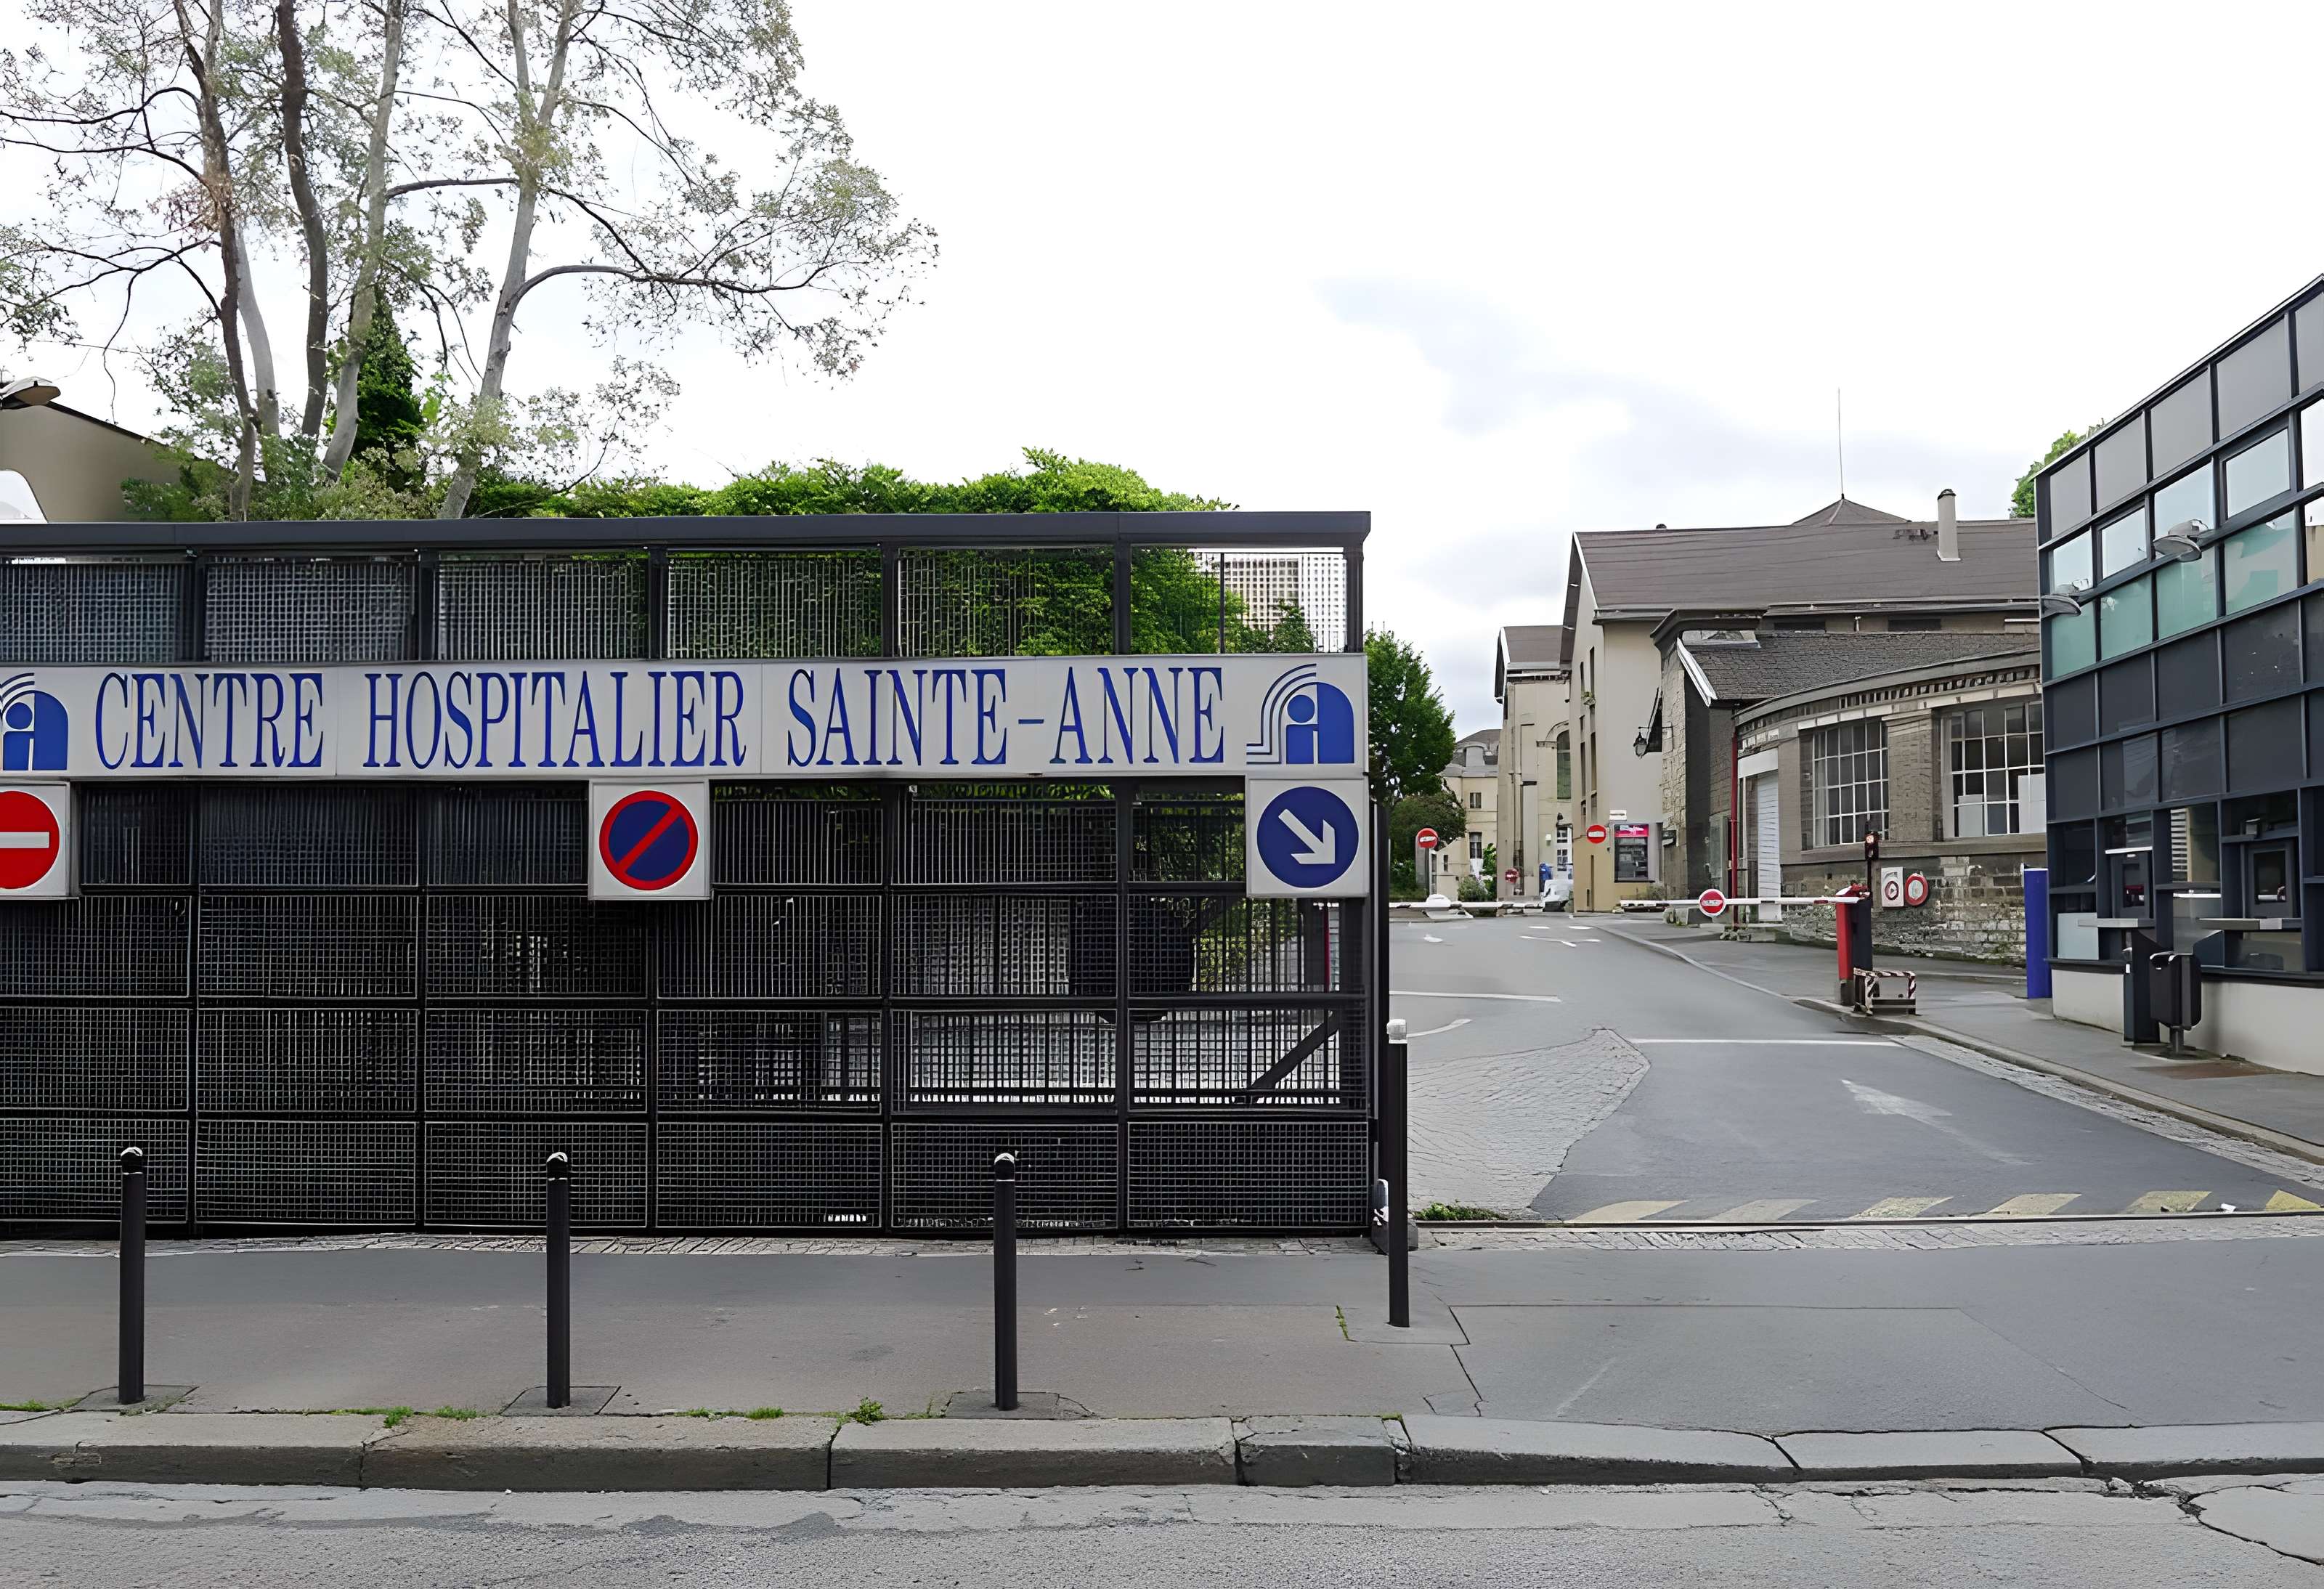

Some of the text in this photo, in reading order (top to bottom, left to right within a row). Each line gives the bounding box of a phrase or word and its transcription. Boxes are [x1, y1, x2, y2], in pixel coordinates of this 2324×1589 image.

[95, 666, 1224, 769] CENTRE HOSPITALIER SAINTE-ANNE
